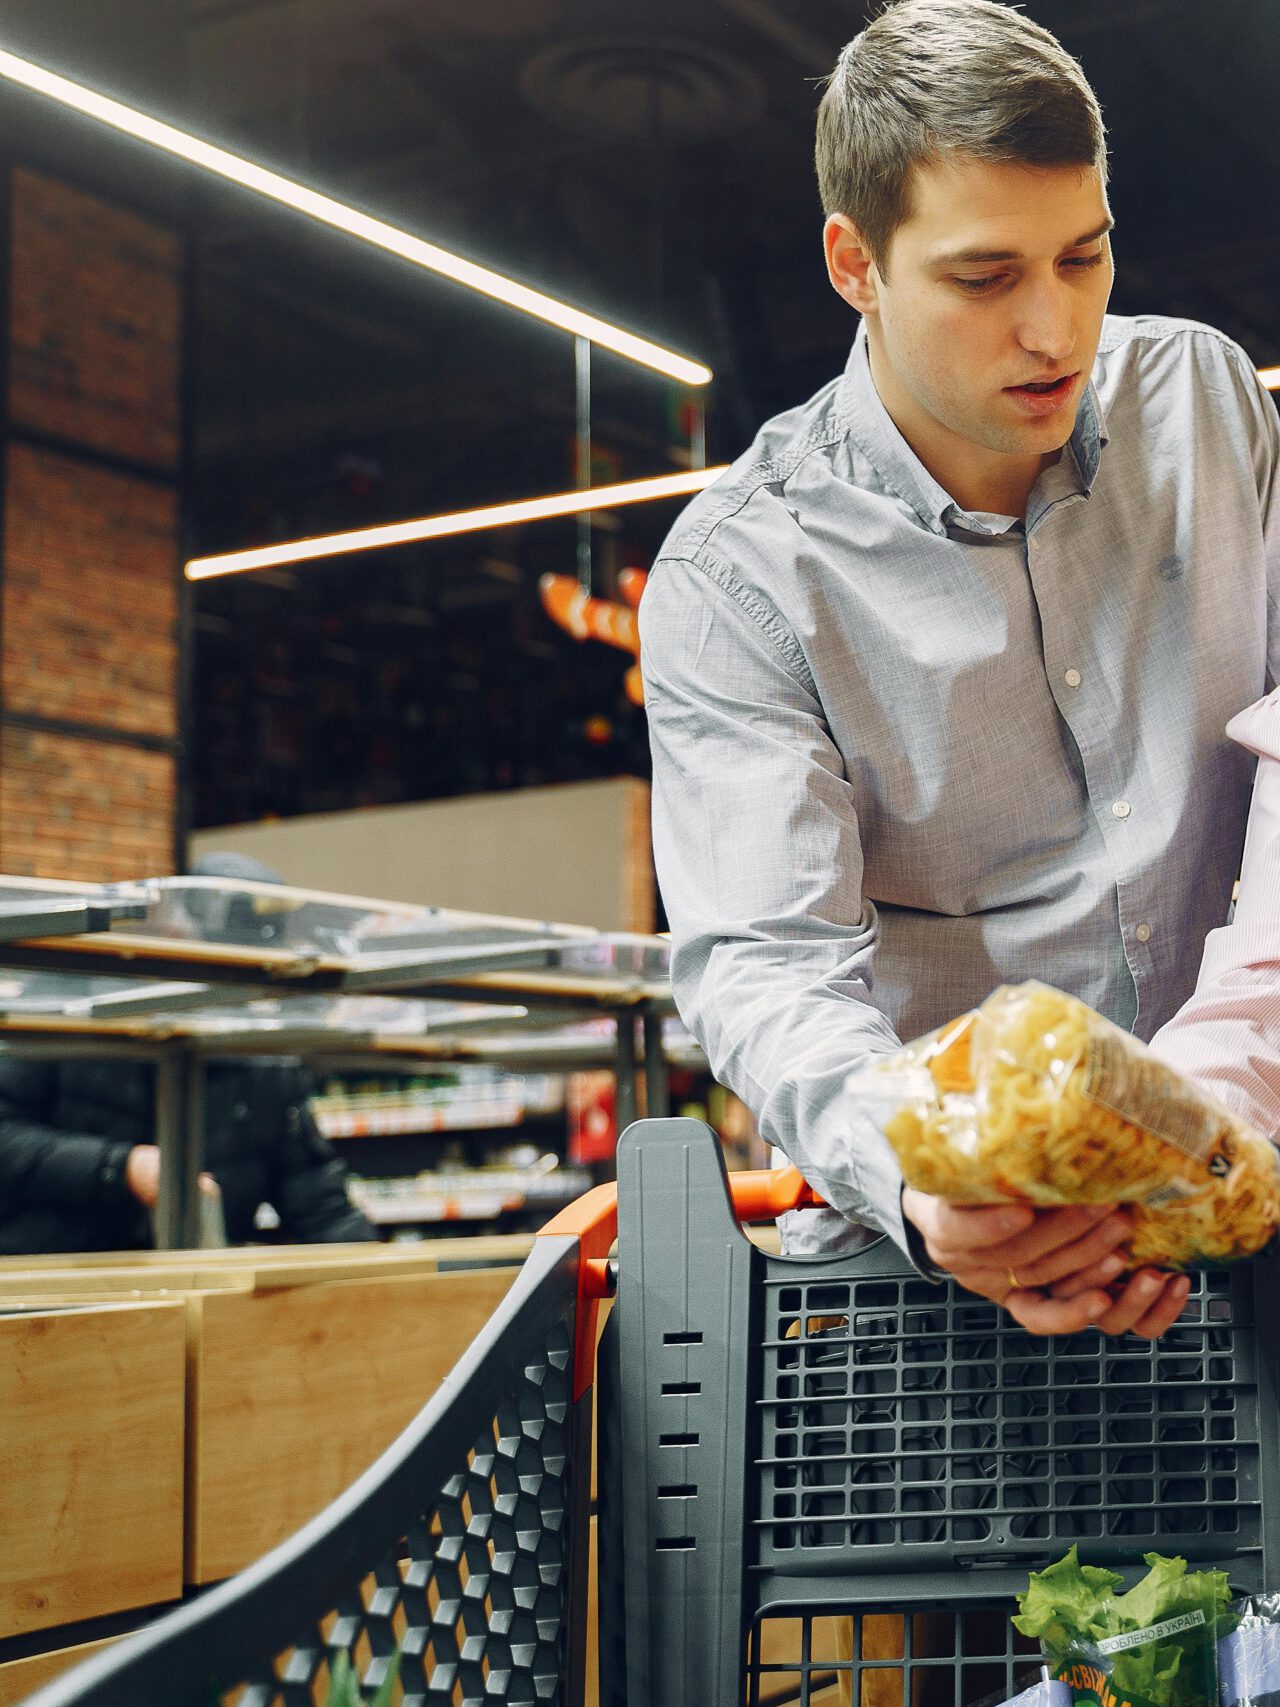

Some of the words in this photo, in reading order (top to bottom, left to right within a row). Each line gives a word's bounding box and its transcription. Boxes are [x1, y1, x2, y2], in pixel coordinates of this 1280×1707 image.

[1100, 1630, 1155, 1653] ЗРОБЛЕНО
[1157, 1626, 1164, 1637] В
[1164, 1612, 1201, 1633] УКРАЇНІ
